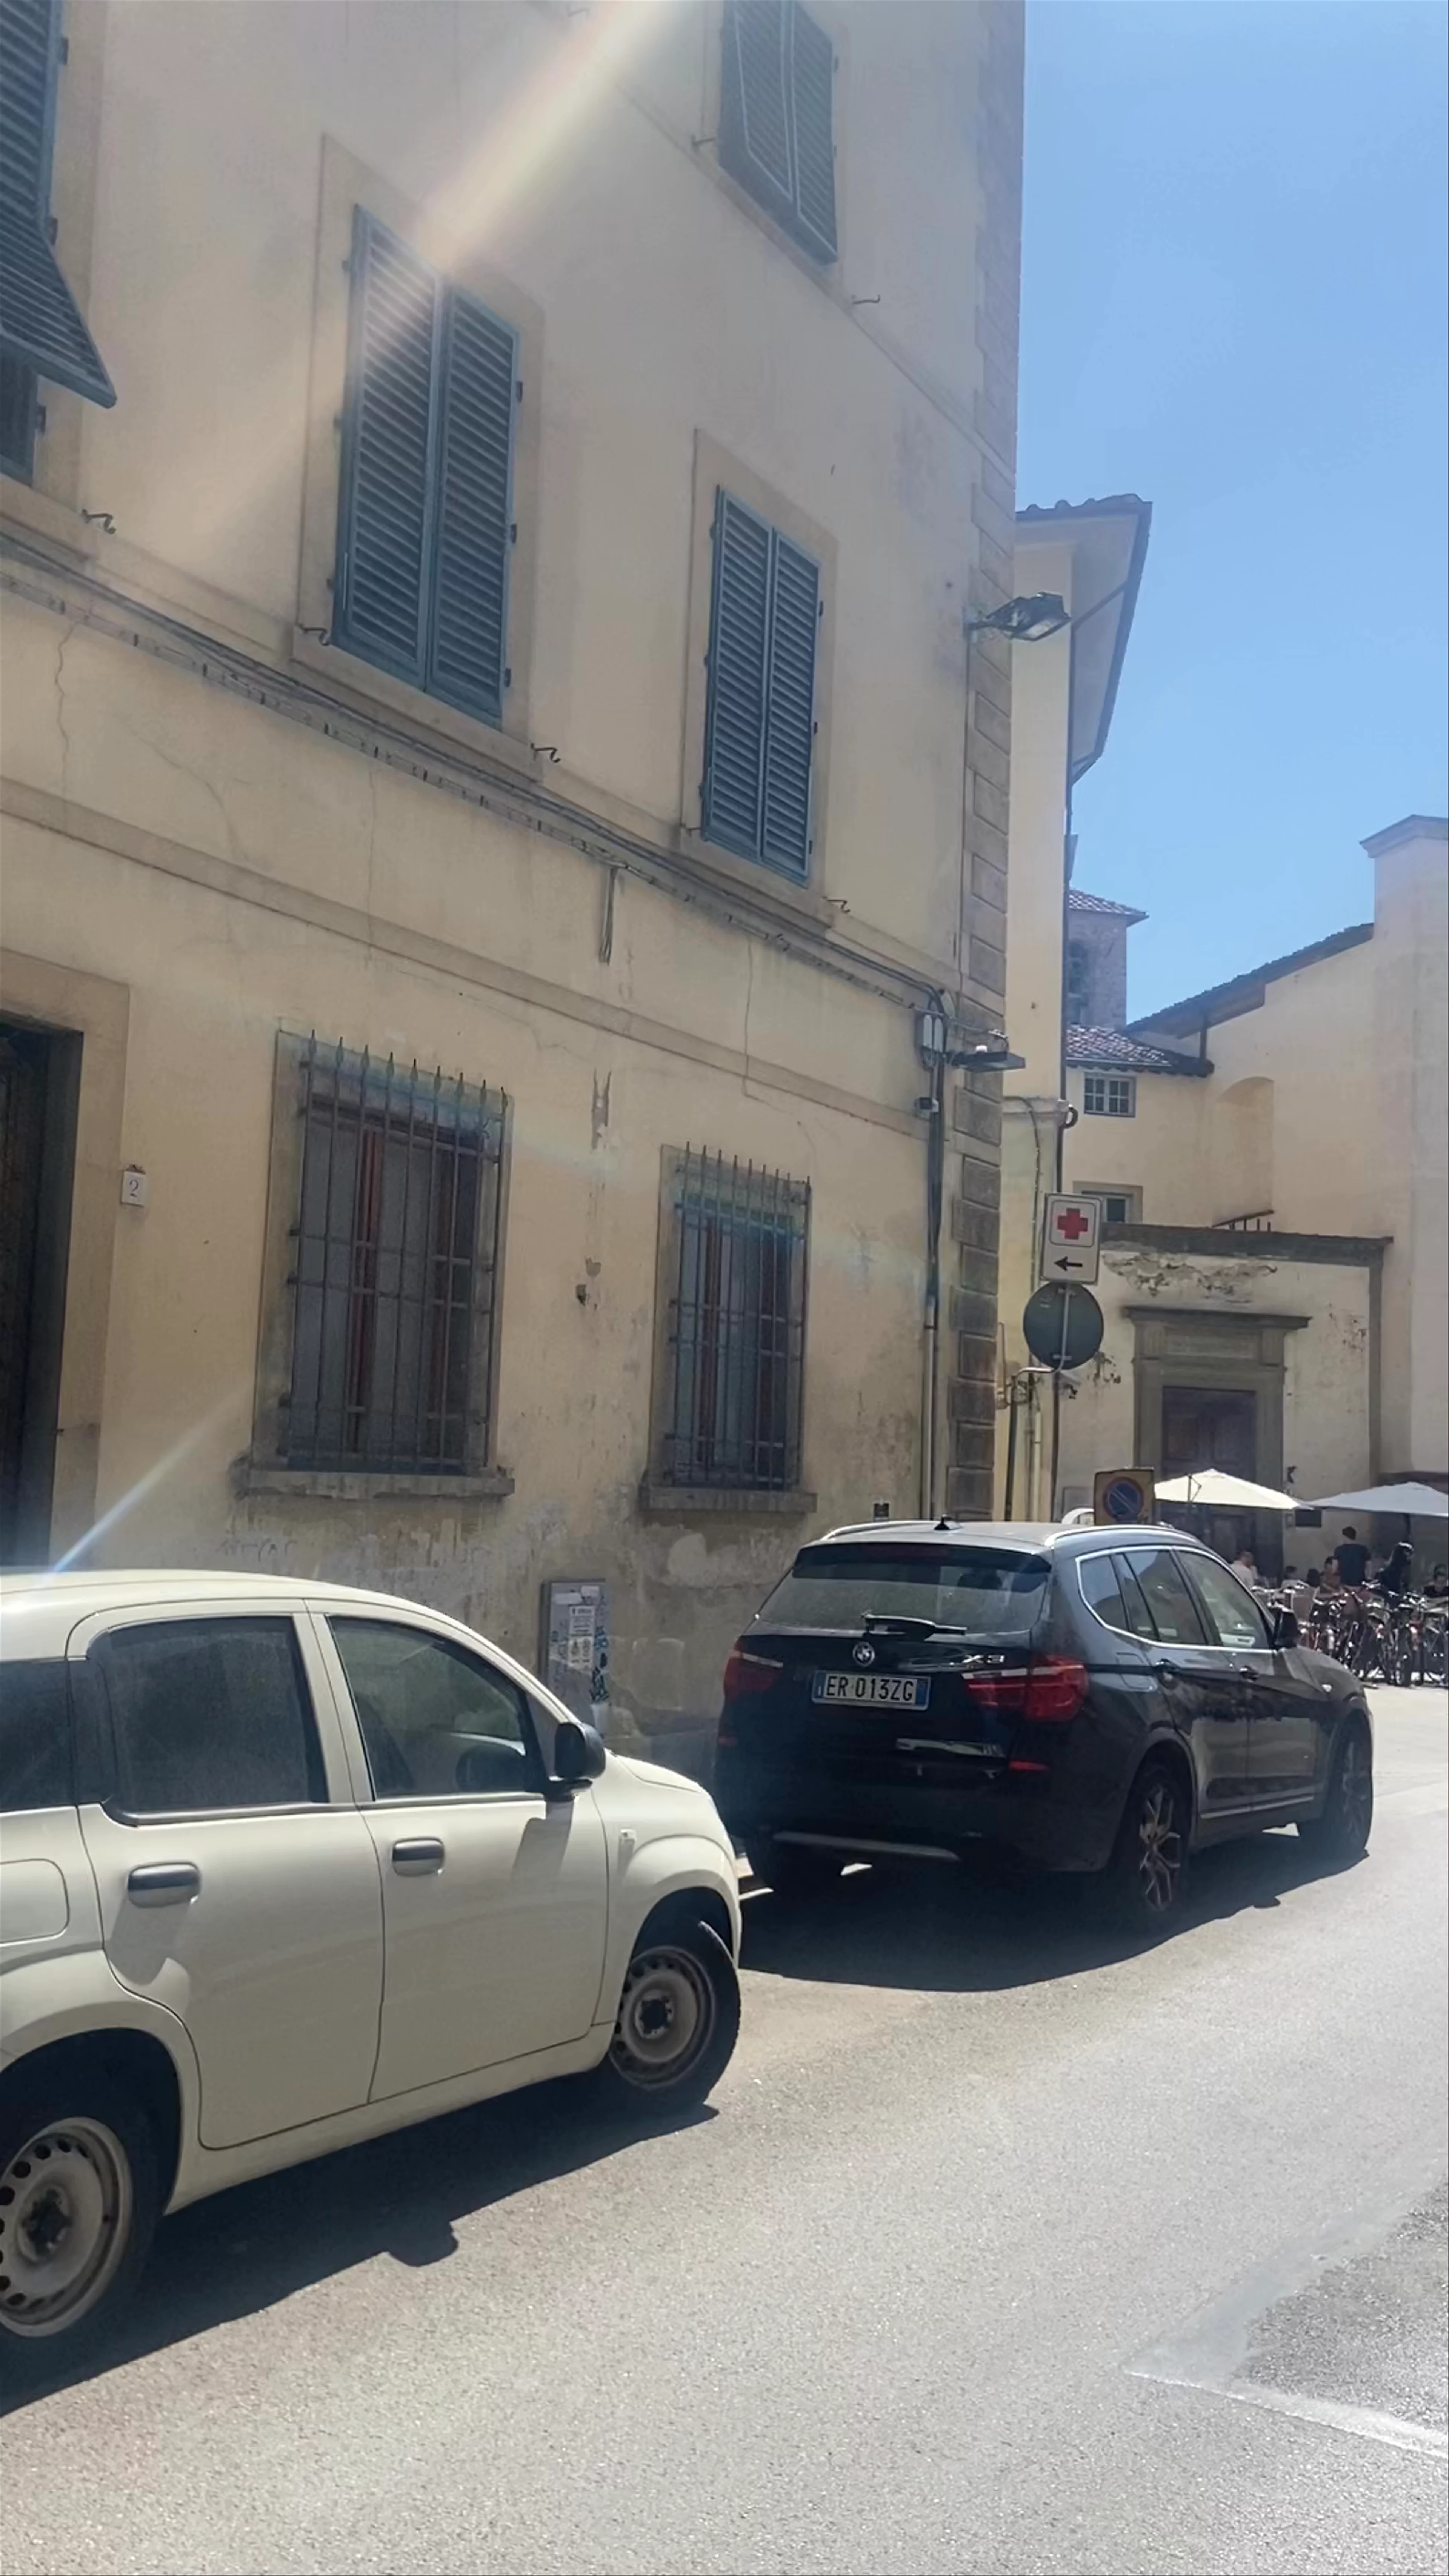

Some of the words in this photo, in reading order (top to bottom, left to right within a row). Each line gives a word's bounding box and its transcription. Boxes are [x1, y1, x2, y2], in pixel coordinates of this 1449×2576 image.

[129, 1179, 138, 1198] 2
[963, 1655, 1005, 1664] X3
[826, 1676, 848, 1697] ER
[855, 1678, 914, 1701] 013ZG
